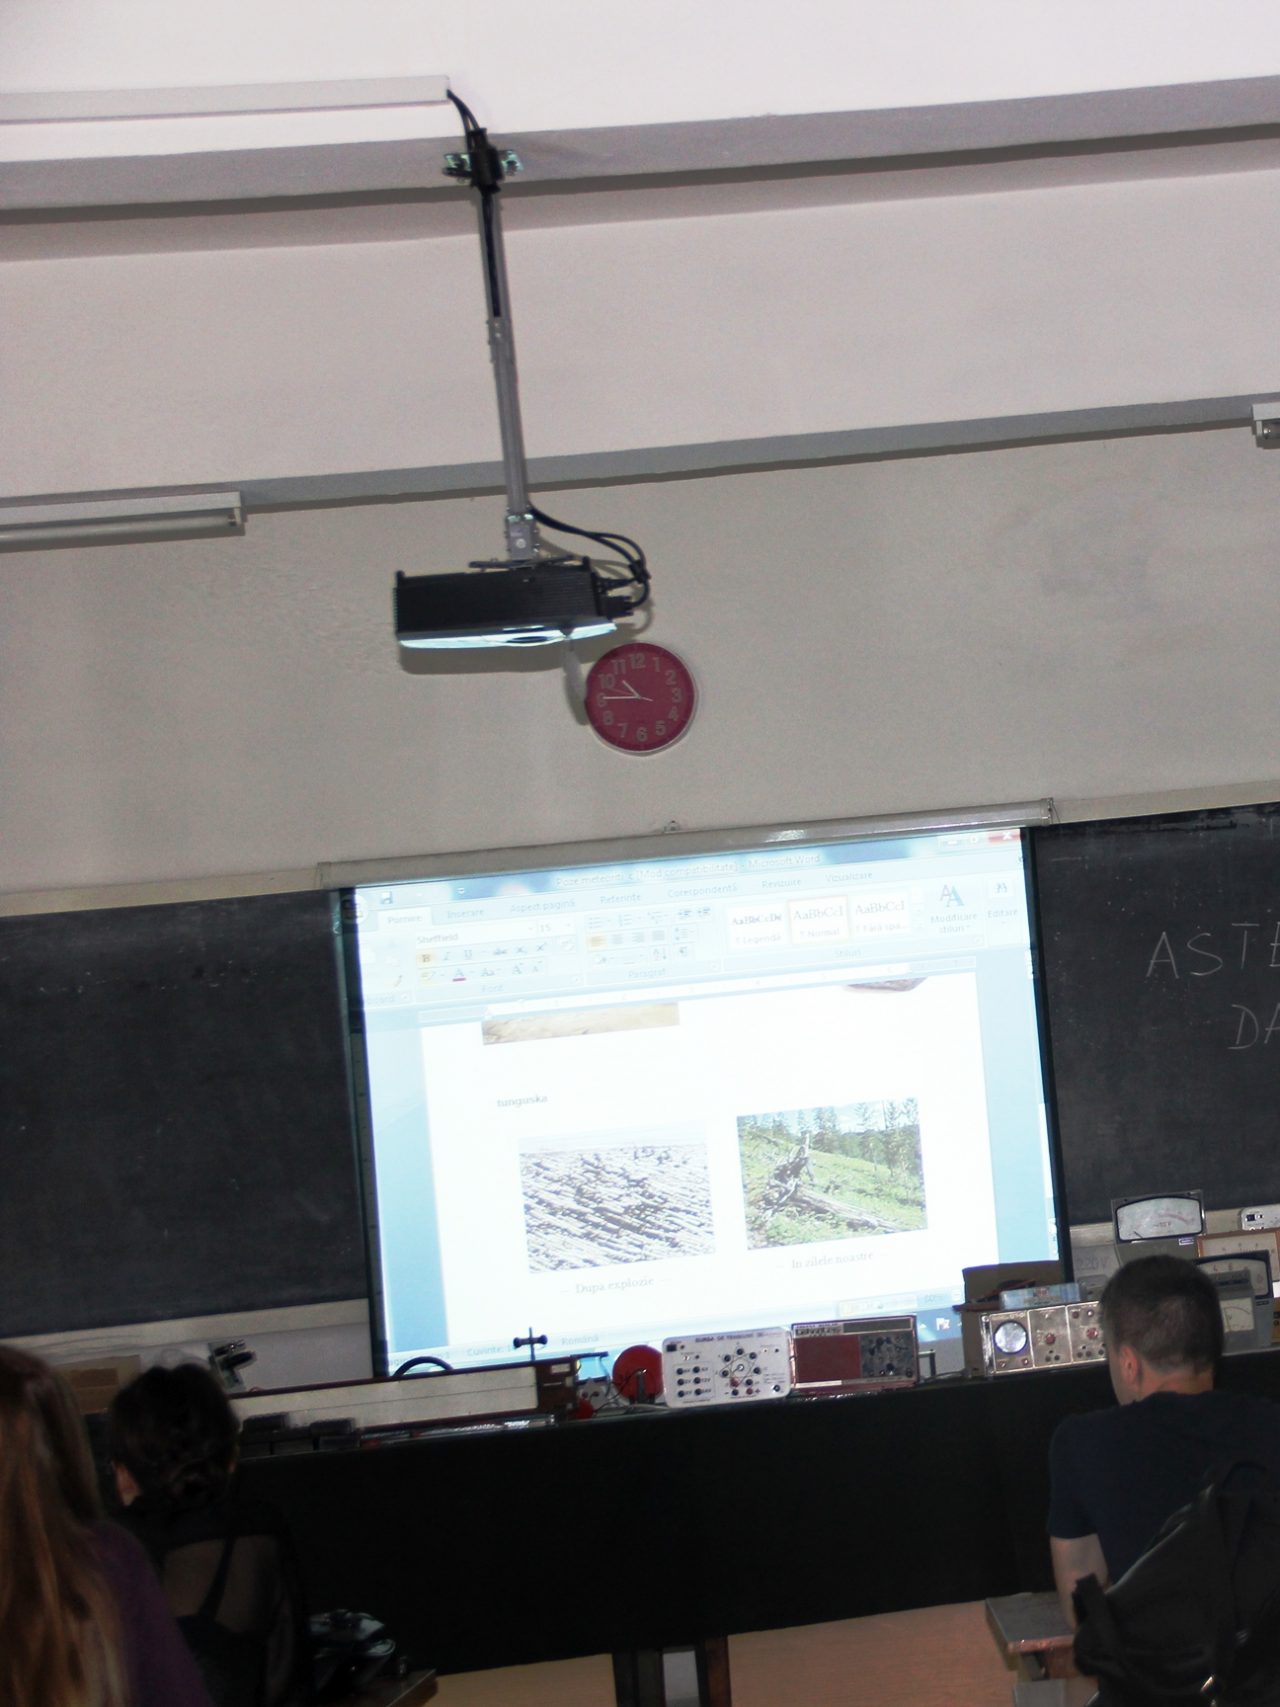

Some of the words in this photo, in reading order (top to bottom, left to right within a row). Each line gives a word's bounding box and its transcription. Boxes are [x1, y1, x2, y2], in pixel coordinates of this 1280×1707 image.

[611, 659, 626, 674] 11
[629, 653, 646, 669] 12
[653, 657, 661, 672] 1
[598, 673, 616, 689] 10
[665, 670, 677, 685] 2
[672, 688, 682, 702] 3
[618, 723, 629, 738] 7
[636, 727, 648, 741] 6
[747, 856, 793, 869] Microsoft
[796, 854, 822, 865] Word
